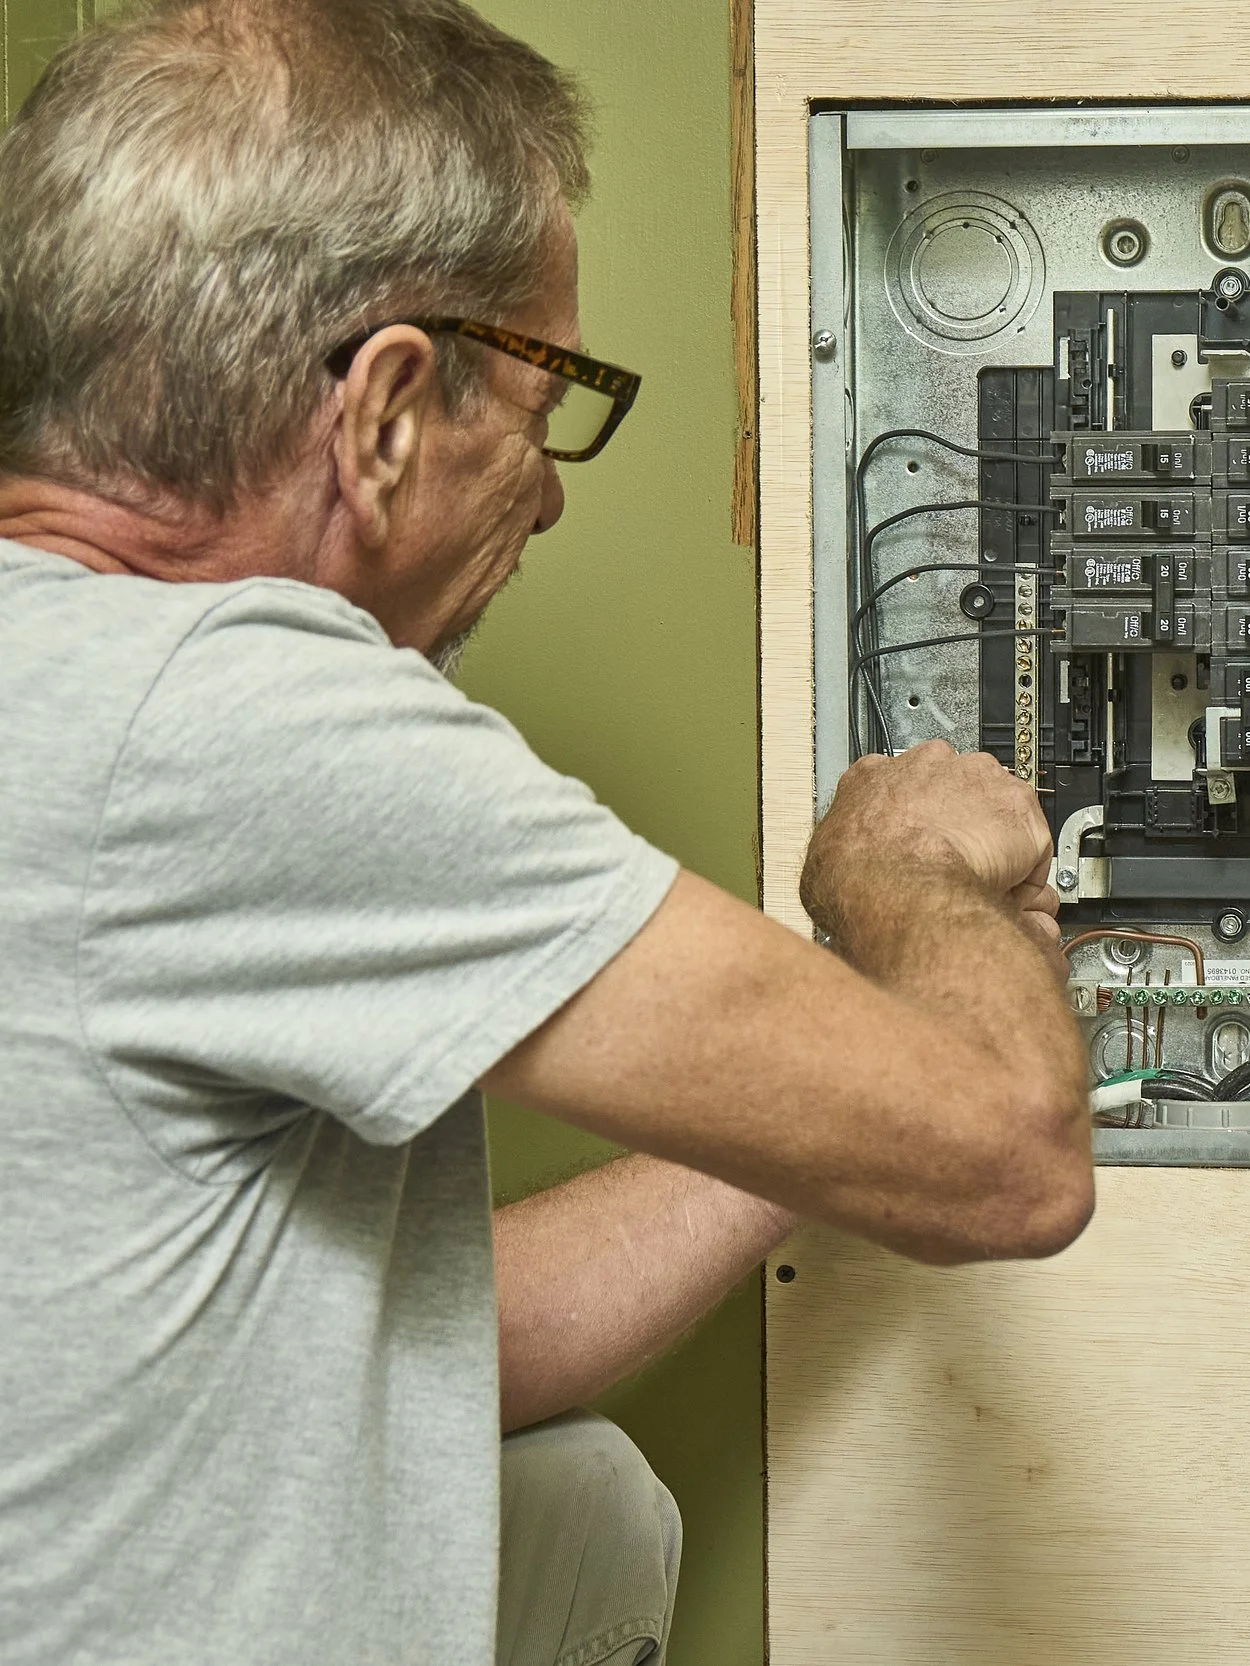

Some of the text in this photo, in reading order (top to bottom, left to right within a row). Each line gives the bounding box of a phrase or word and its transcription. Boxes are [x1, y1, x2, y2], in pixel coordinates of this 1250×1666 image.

[1160, 454, 1169, 464] 15
[1160, 509, 1169, 519] 15
[1160, 565, 1169, 577] 20
[1160, 619, 1169, 632] 20
